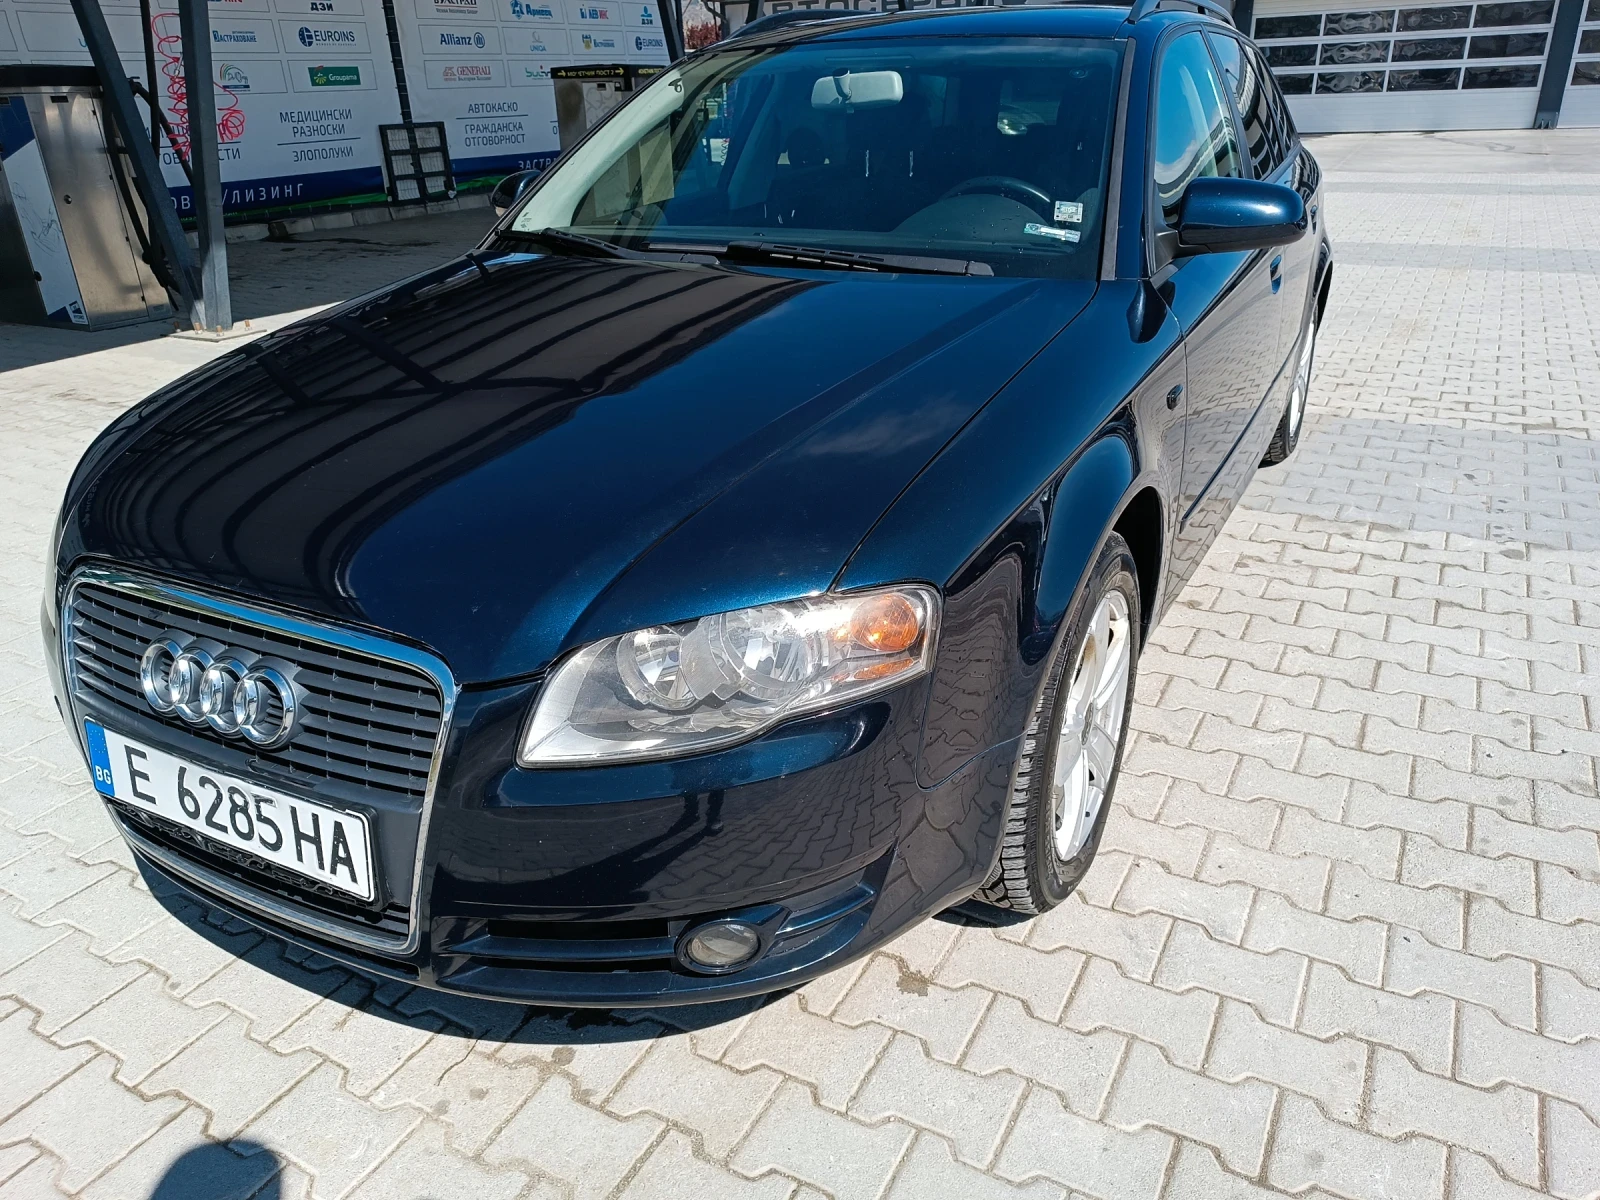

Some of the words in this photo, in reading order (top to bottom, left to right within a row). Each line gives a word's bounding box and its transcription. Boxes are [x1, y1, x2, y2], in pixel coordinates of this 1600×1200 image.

[310, 2, 333, 11] ДЗИ
[313, 30, 356, 42] EUROINS
[439, 33, 472, 46] Allianz
[642, 38, 664, 47] EUROINS
[329, 73, 358, 81] Groupama
[456, 66, 491, 76] GENERALI
[467, 102, 518, 114] АВТОКАСКО
[279, 109, 353, 123] МЕДИЦИНСКИ
[292, 124, 346, 138] РАЗНОСКИ
[464, 121, 525, 135] ГРАЖДАНСКА
[464, 134, 526, 147] ОТГОВОРНОСТ
[292, 146, 354, 162] ЗЛОПОЛУКИ
[94, 764, 113, 786] BG
[123, 744, 158, 806] E
[177, 765, 284, 852] 6285
[289, 804, 360, 885] HA
